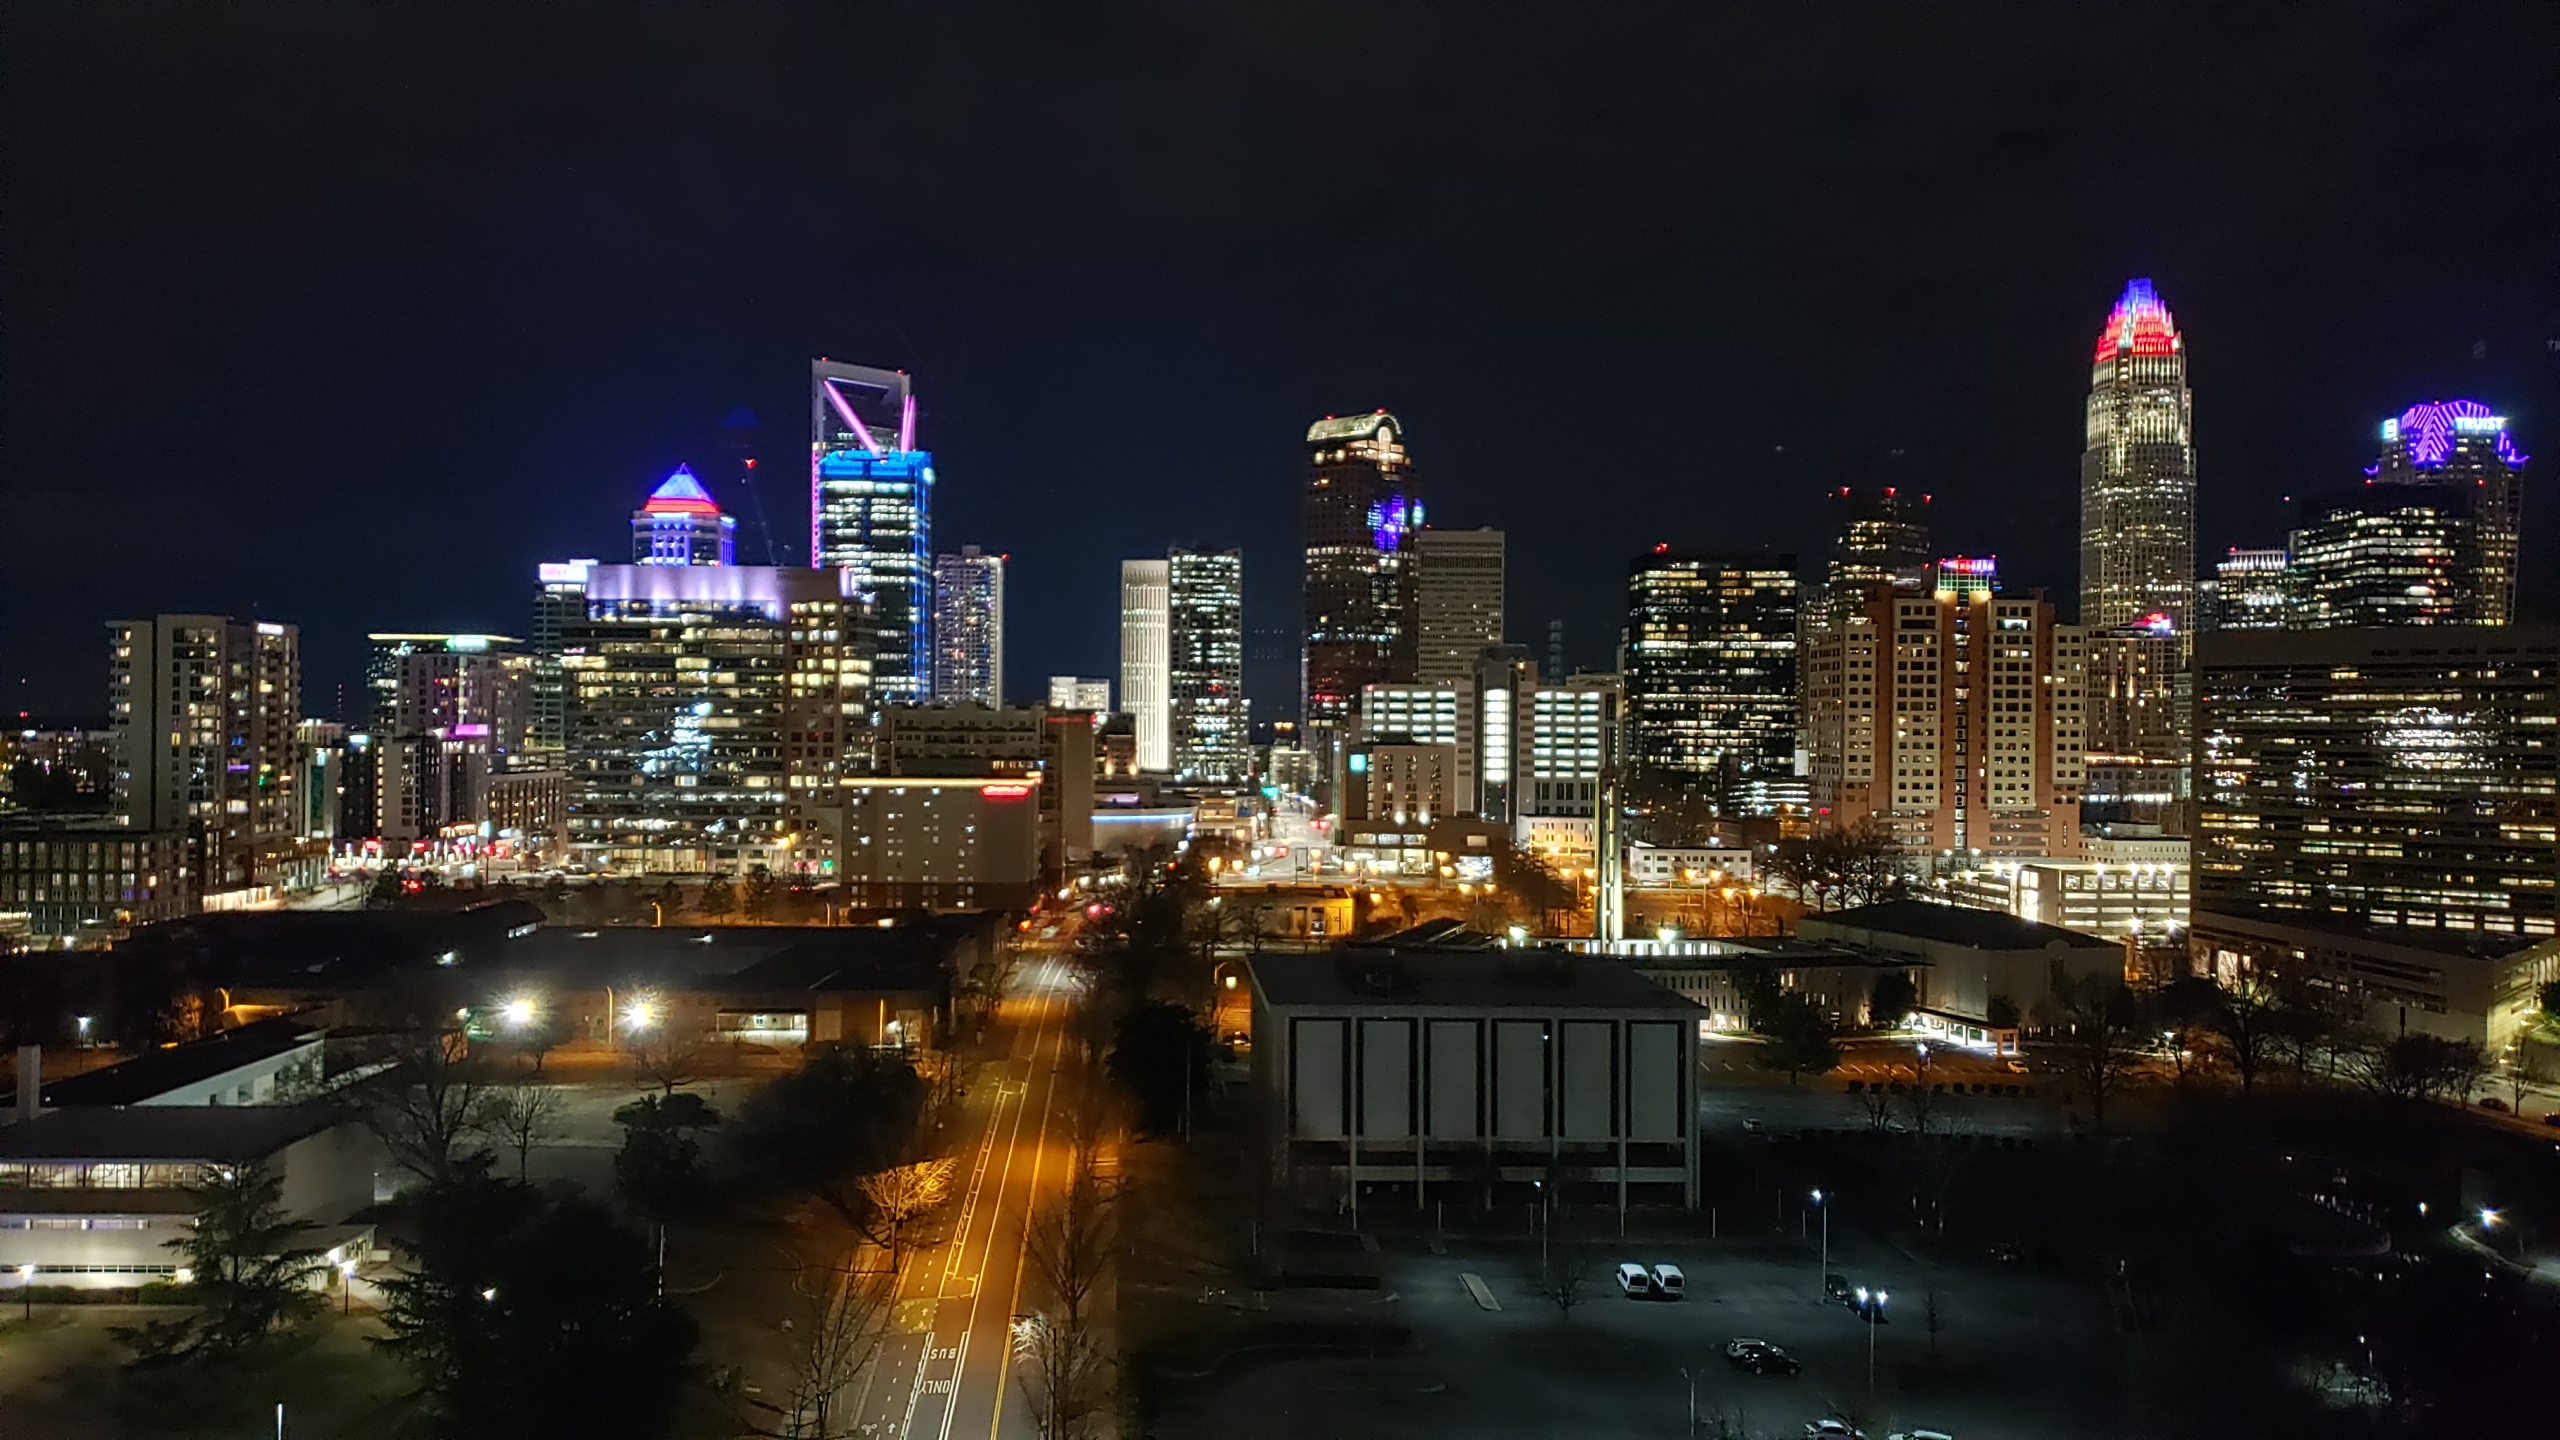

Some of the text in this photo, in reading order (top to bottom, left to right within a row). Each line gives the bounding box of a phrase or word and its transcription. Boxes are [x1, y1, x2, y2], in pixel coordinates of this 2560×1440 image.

[2455, 416, 2505, 430] TRUIST
[930, 1347, 957, 1360] BUS
[918, 1379, 952, 1394] ONLY
